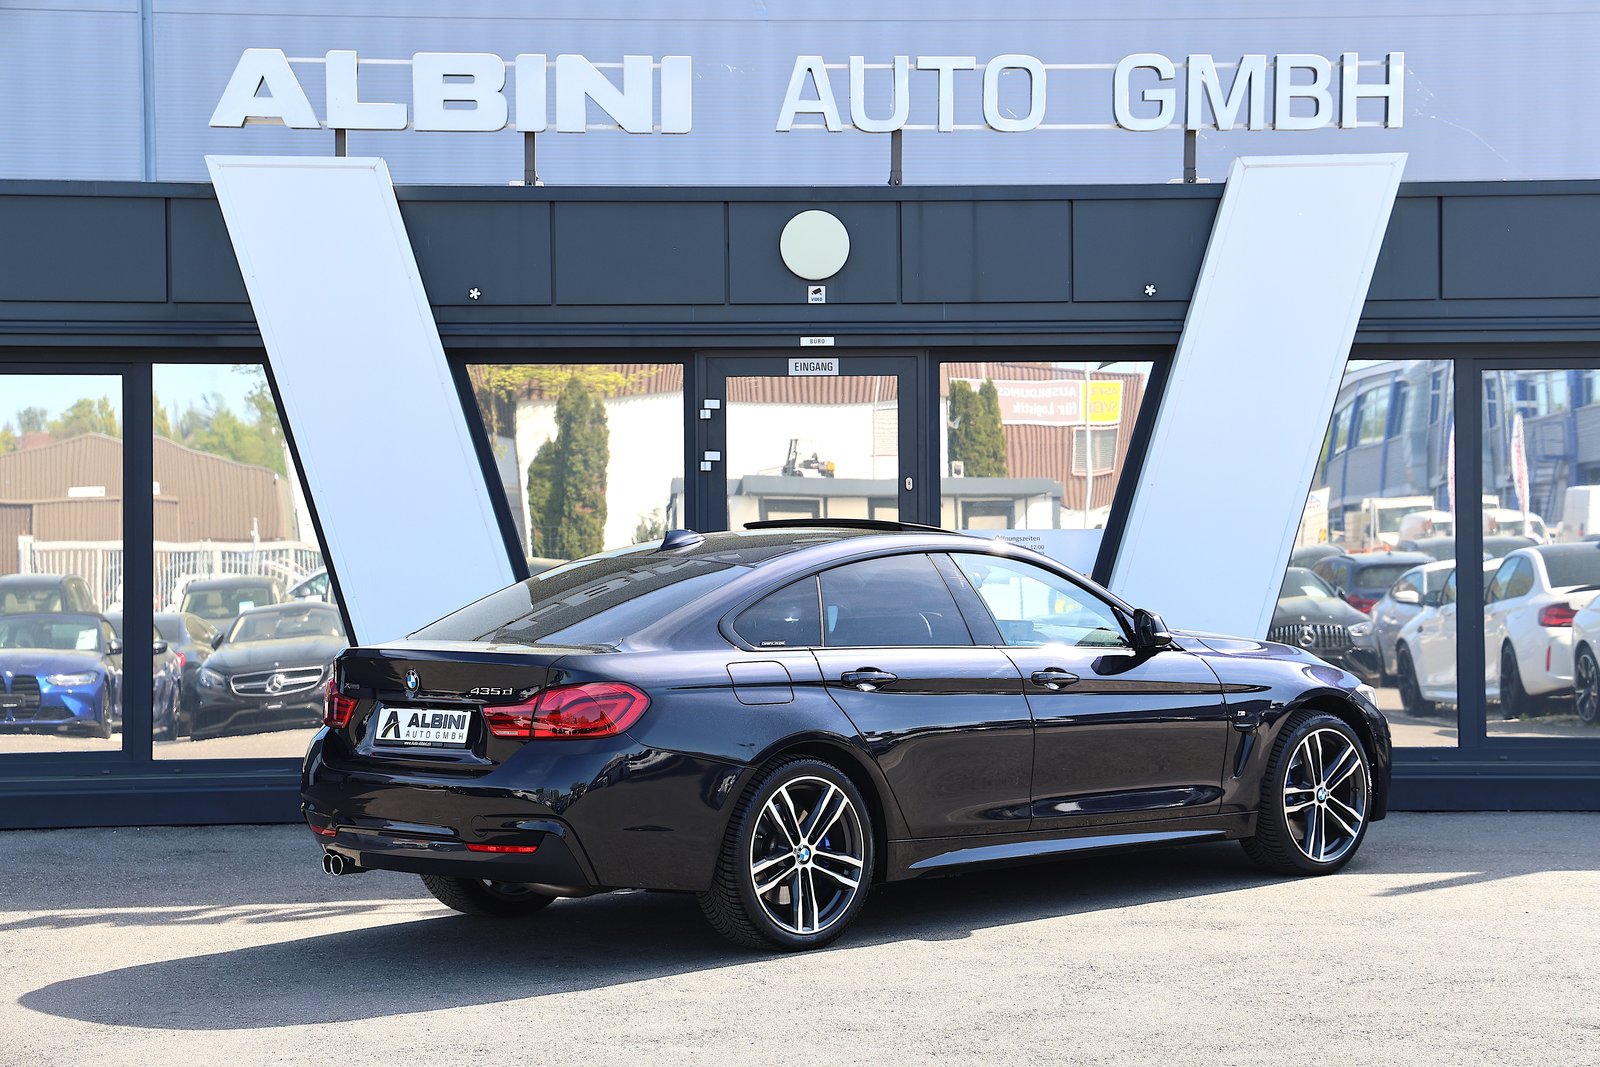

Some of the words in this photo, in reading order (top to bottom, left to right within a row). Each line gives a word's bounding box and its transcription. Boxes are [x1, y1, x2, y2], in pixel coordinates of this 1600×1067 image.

[208, 48, 692, 134] ALBINI
[775, 53, 1047, 133] AUTO
[1112, 51, 1405, 132] GMBH
[794, 362, 833, 372] EINGANG
[407, 713, 467, 730] ALBINI
[405, 730, 431, 739] AUTO
[435, 731, 464, 740] GMBH
